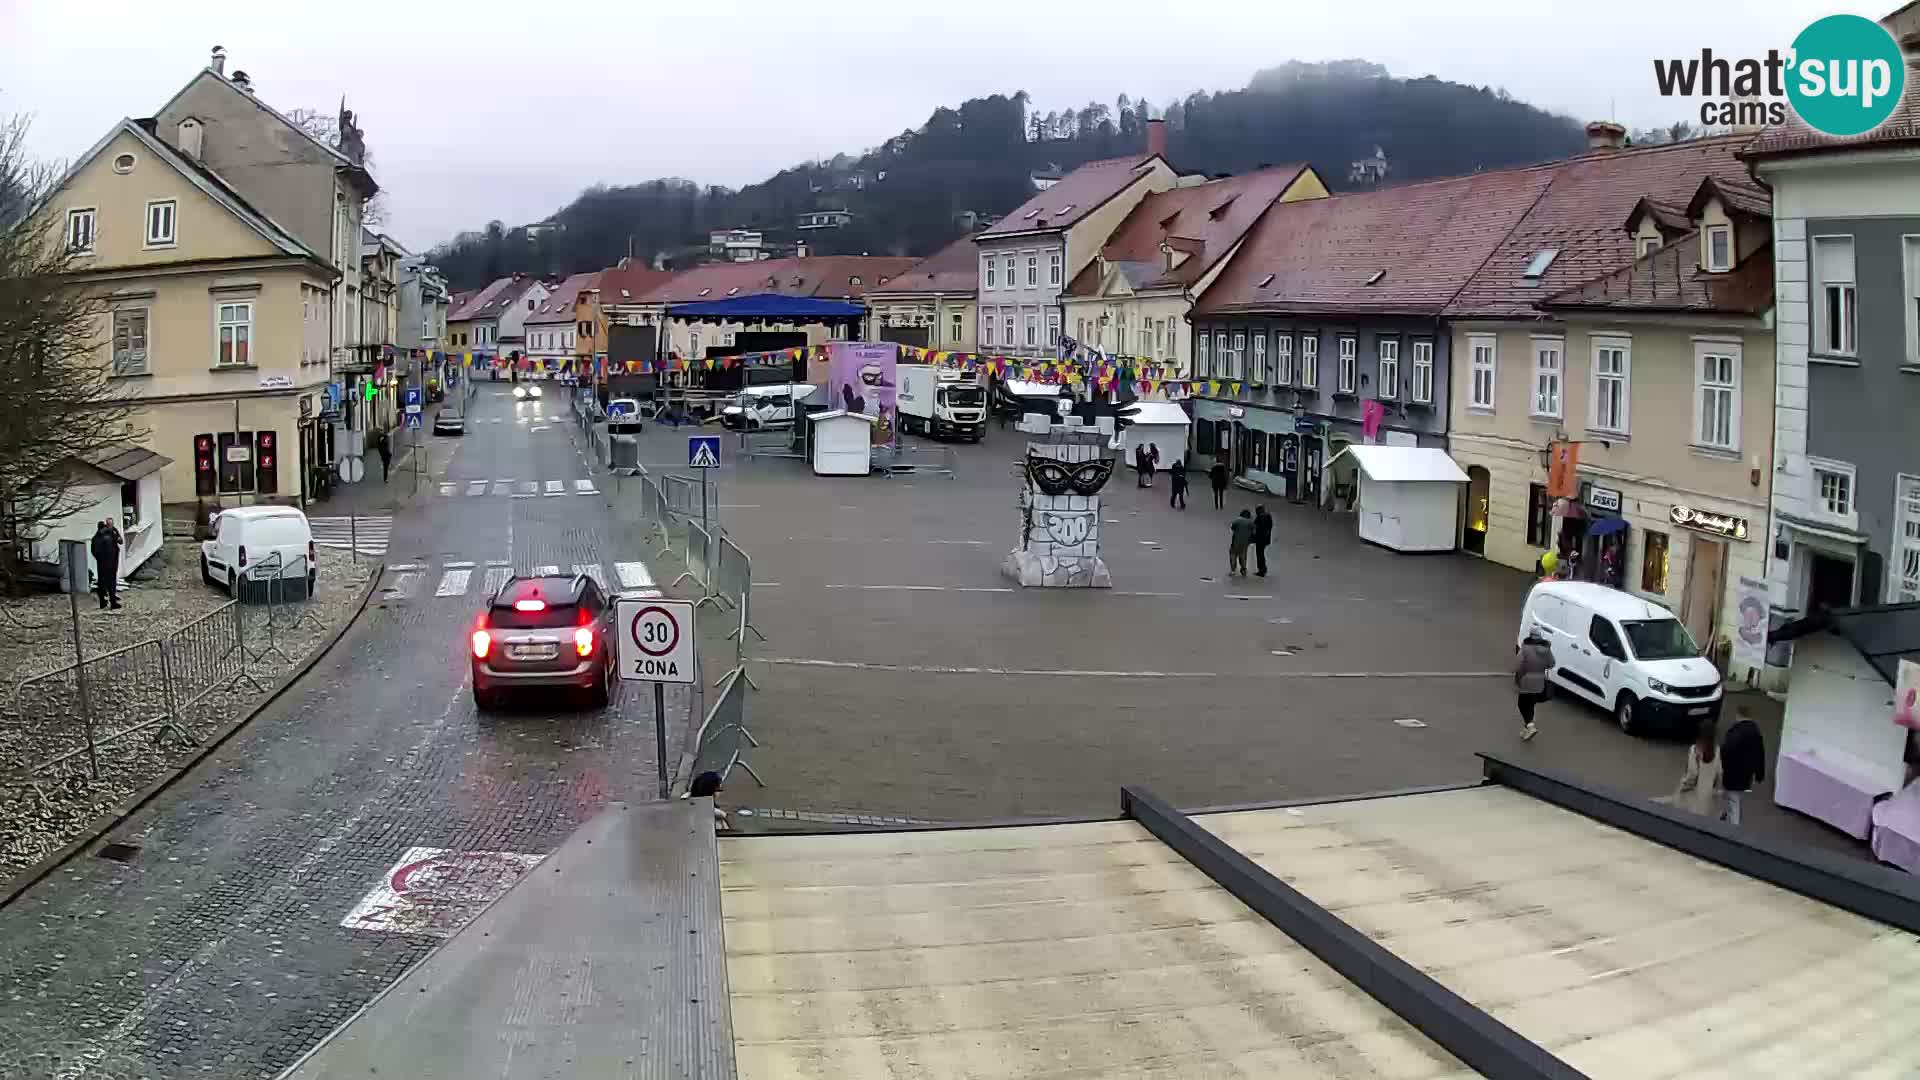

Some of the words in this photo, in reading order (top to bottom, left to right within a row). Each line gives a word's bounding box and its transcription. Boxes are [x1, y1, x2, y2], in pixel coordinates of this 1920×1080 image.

[409, 391, 417, 402] P
[1049, 516, 1089, 545] 200
[644, 622, 668, 643] 30
[634, 659, 679, 676] ZONA
